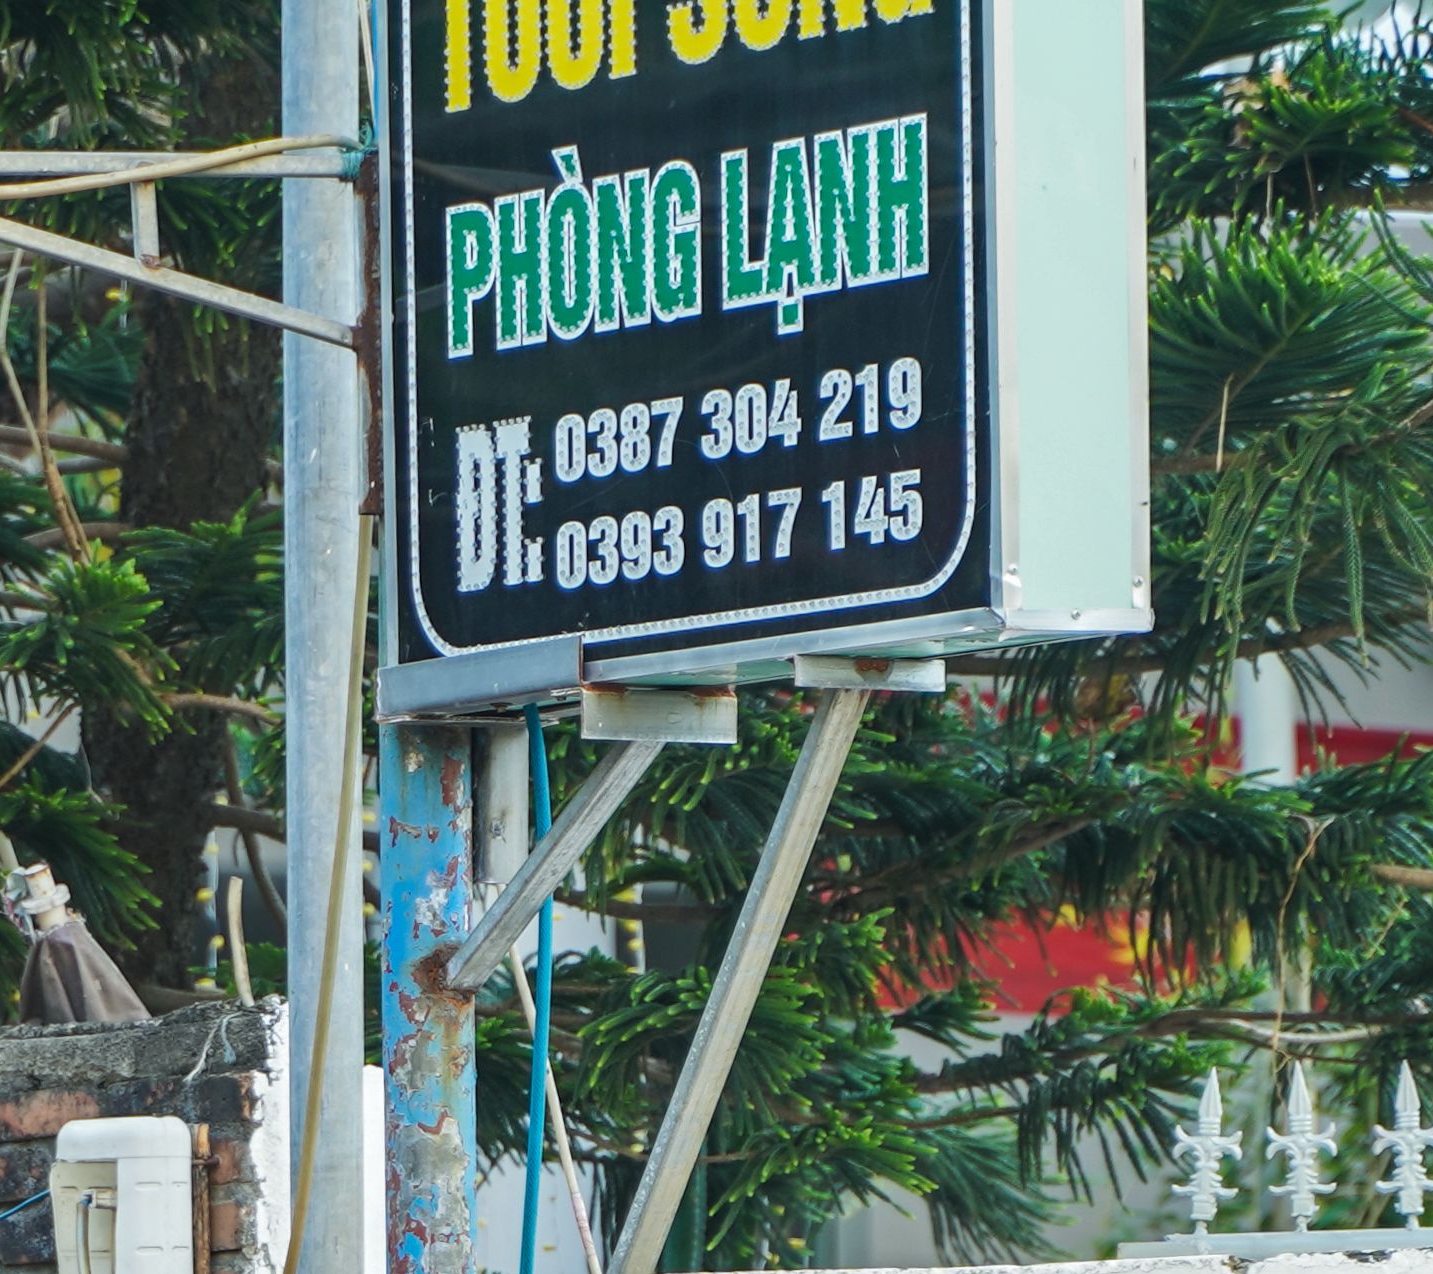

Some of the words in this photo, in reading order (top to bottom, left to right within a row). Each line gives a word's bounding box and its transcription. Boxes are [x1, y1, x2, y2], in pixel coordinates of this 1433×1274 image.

[445, 144, 702, 359] PHÒNG
[721, 112, 929, 335] LẠNH
[554, 396, 683, 484] 0387
[700, 378, 801, 460] 304
[818, 357, 922, 442] 219
[555, 505, 685, 591] 0393
[702, 486, 802, 568] 917
[821, 468, 923, 550] 145
